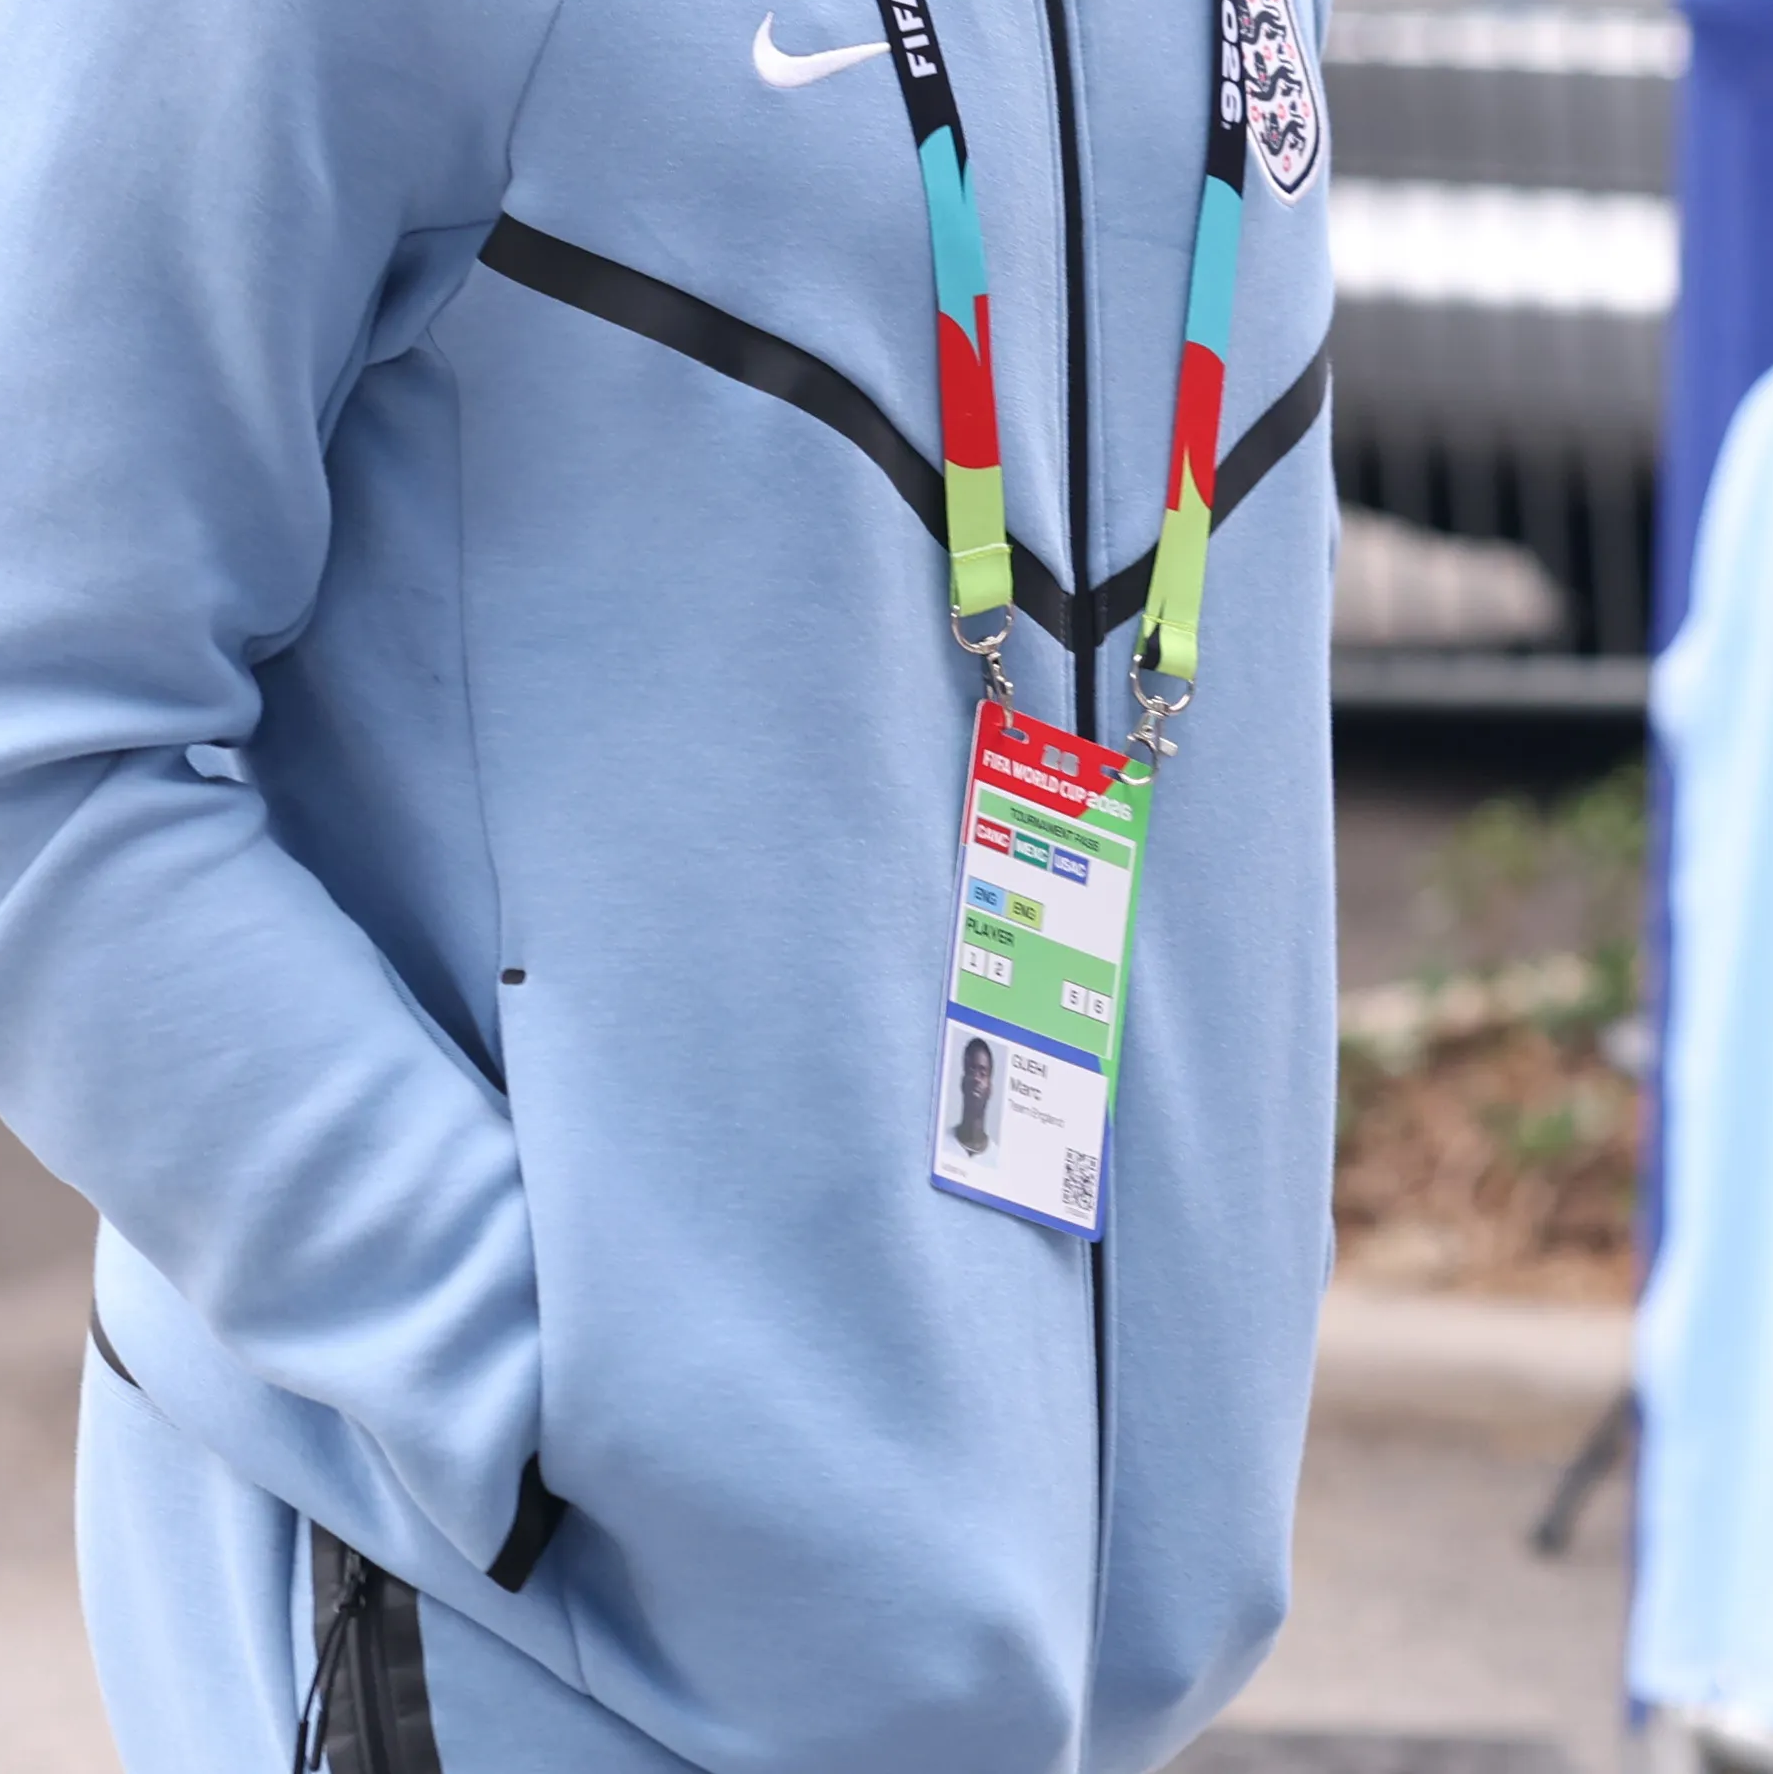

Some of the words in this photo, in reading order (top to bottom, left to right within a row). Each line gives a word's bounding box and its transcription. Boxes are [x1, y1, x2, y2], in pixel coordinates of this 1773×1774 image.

[982, 749, 1012, 776] FIFA
[1012, 760, 1059, 793] WORLD
[1059, 781, 1087, 804] CUP
[1086, 792, 1133, 822] 2026
[966, 916, 1015, 948] PLAYER
